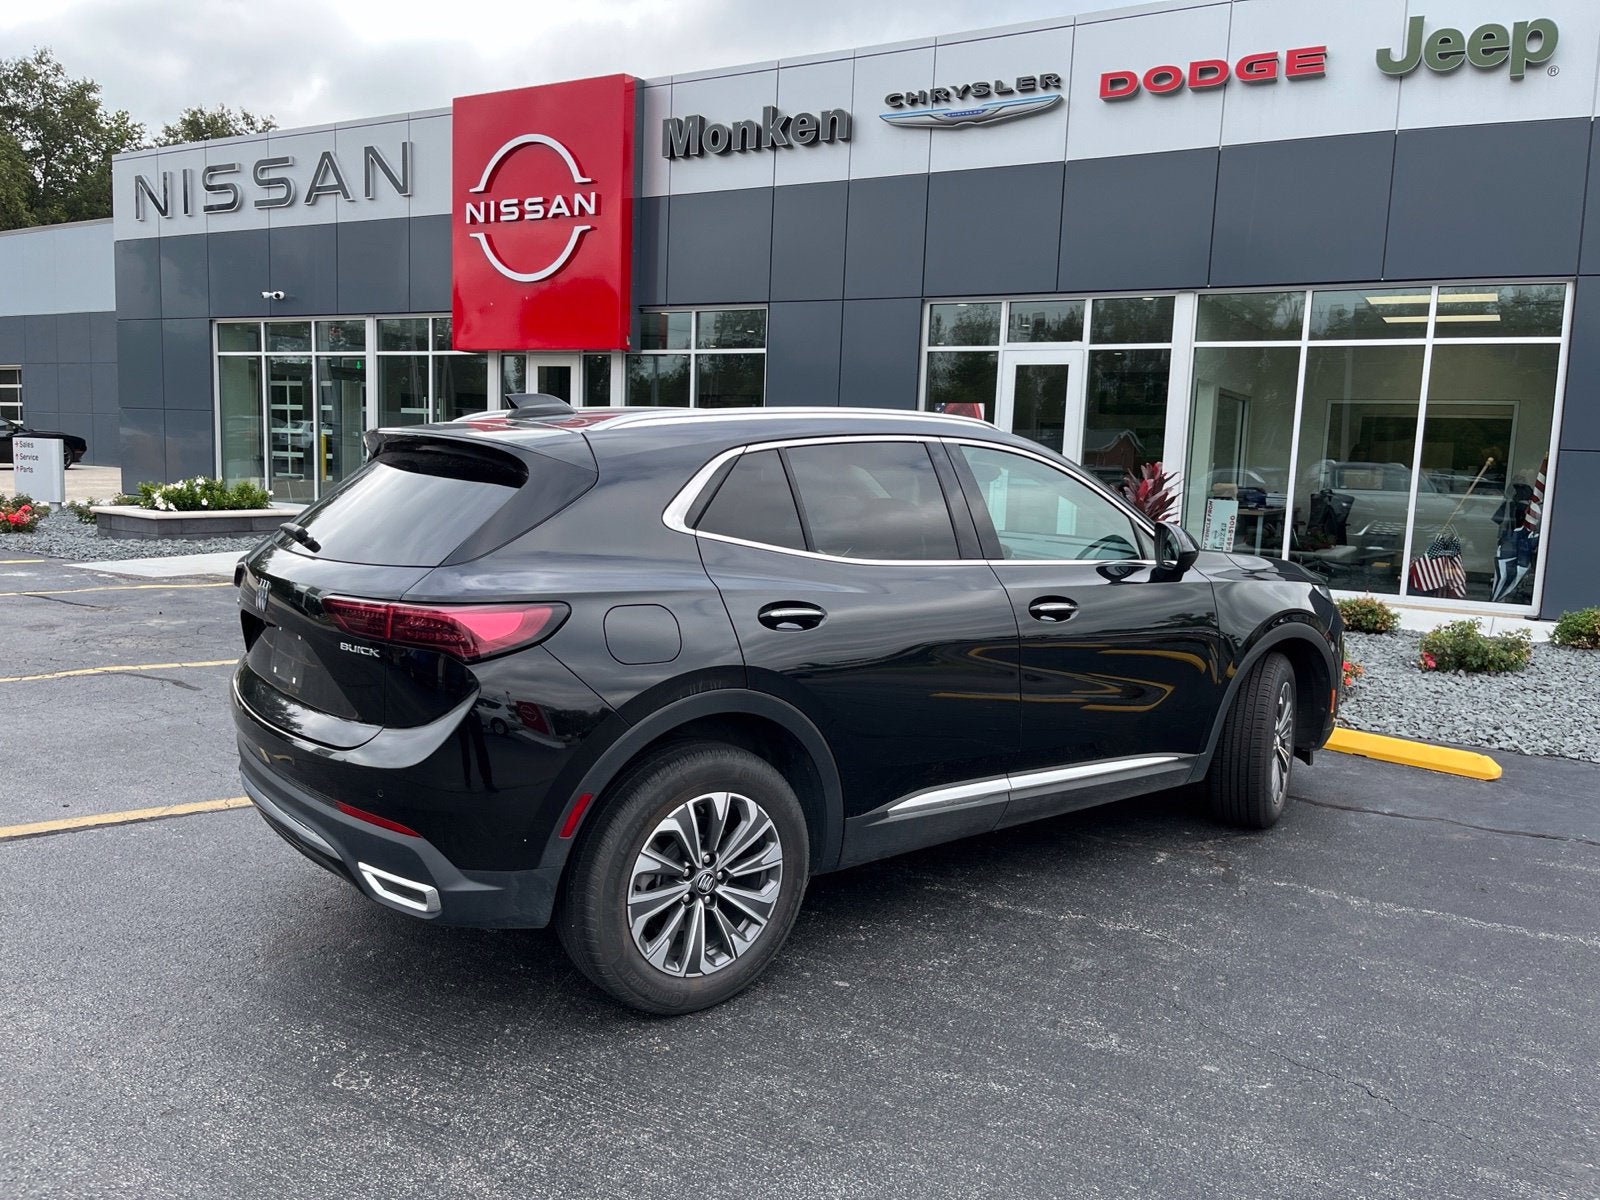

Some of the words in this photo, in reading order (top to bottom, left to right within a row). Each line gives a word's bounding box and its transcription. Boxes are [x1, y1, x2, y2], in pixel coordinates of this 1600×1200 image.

[1375, 14, 1559, 82] Jeep
[884, 72, 1063, 108] CHRYSLER
[1099, 45, 1328, 103] DODGE
[662, 105, 853, 159] Monken
[134, 141, 413, 221] NISSAN
[465, 191, 597, 225] NISSAN
[19, 440, 35, 449] Sales
[19, 452, 40, 461] Service
[19, 465, 34, 473] Parts
[340, 641, 381, 658] BUICK
